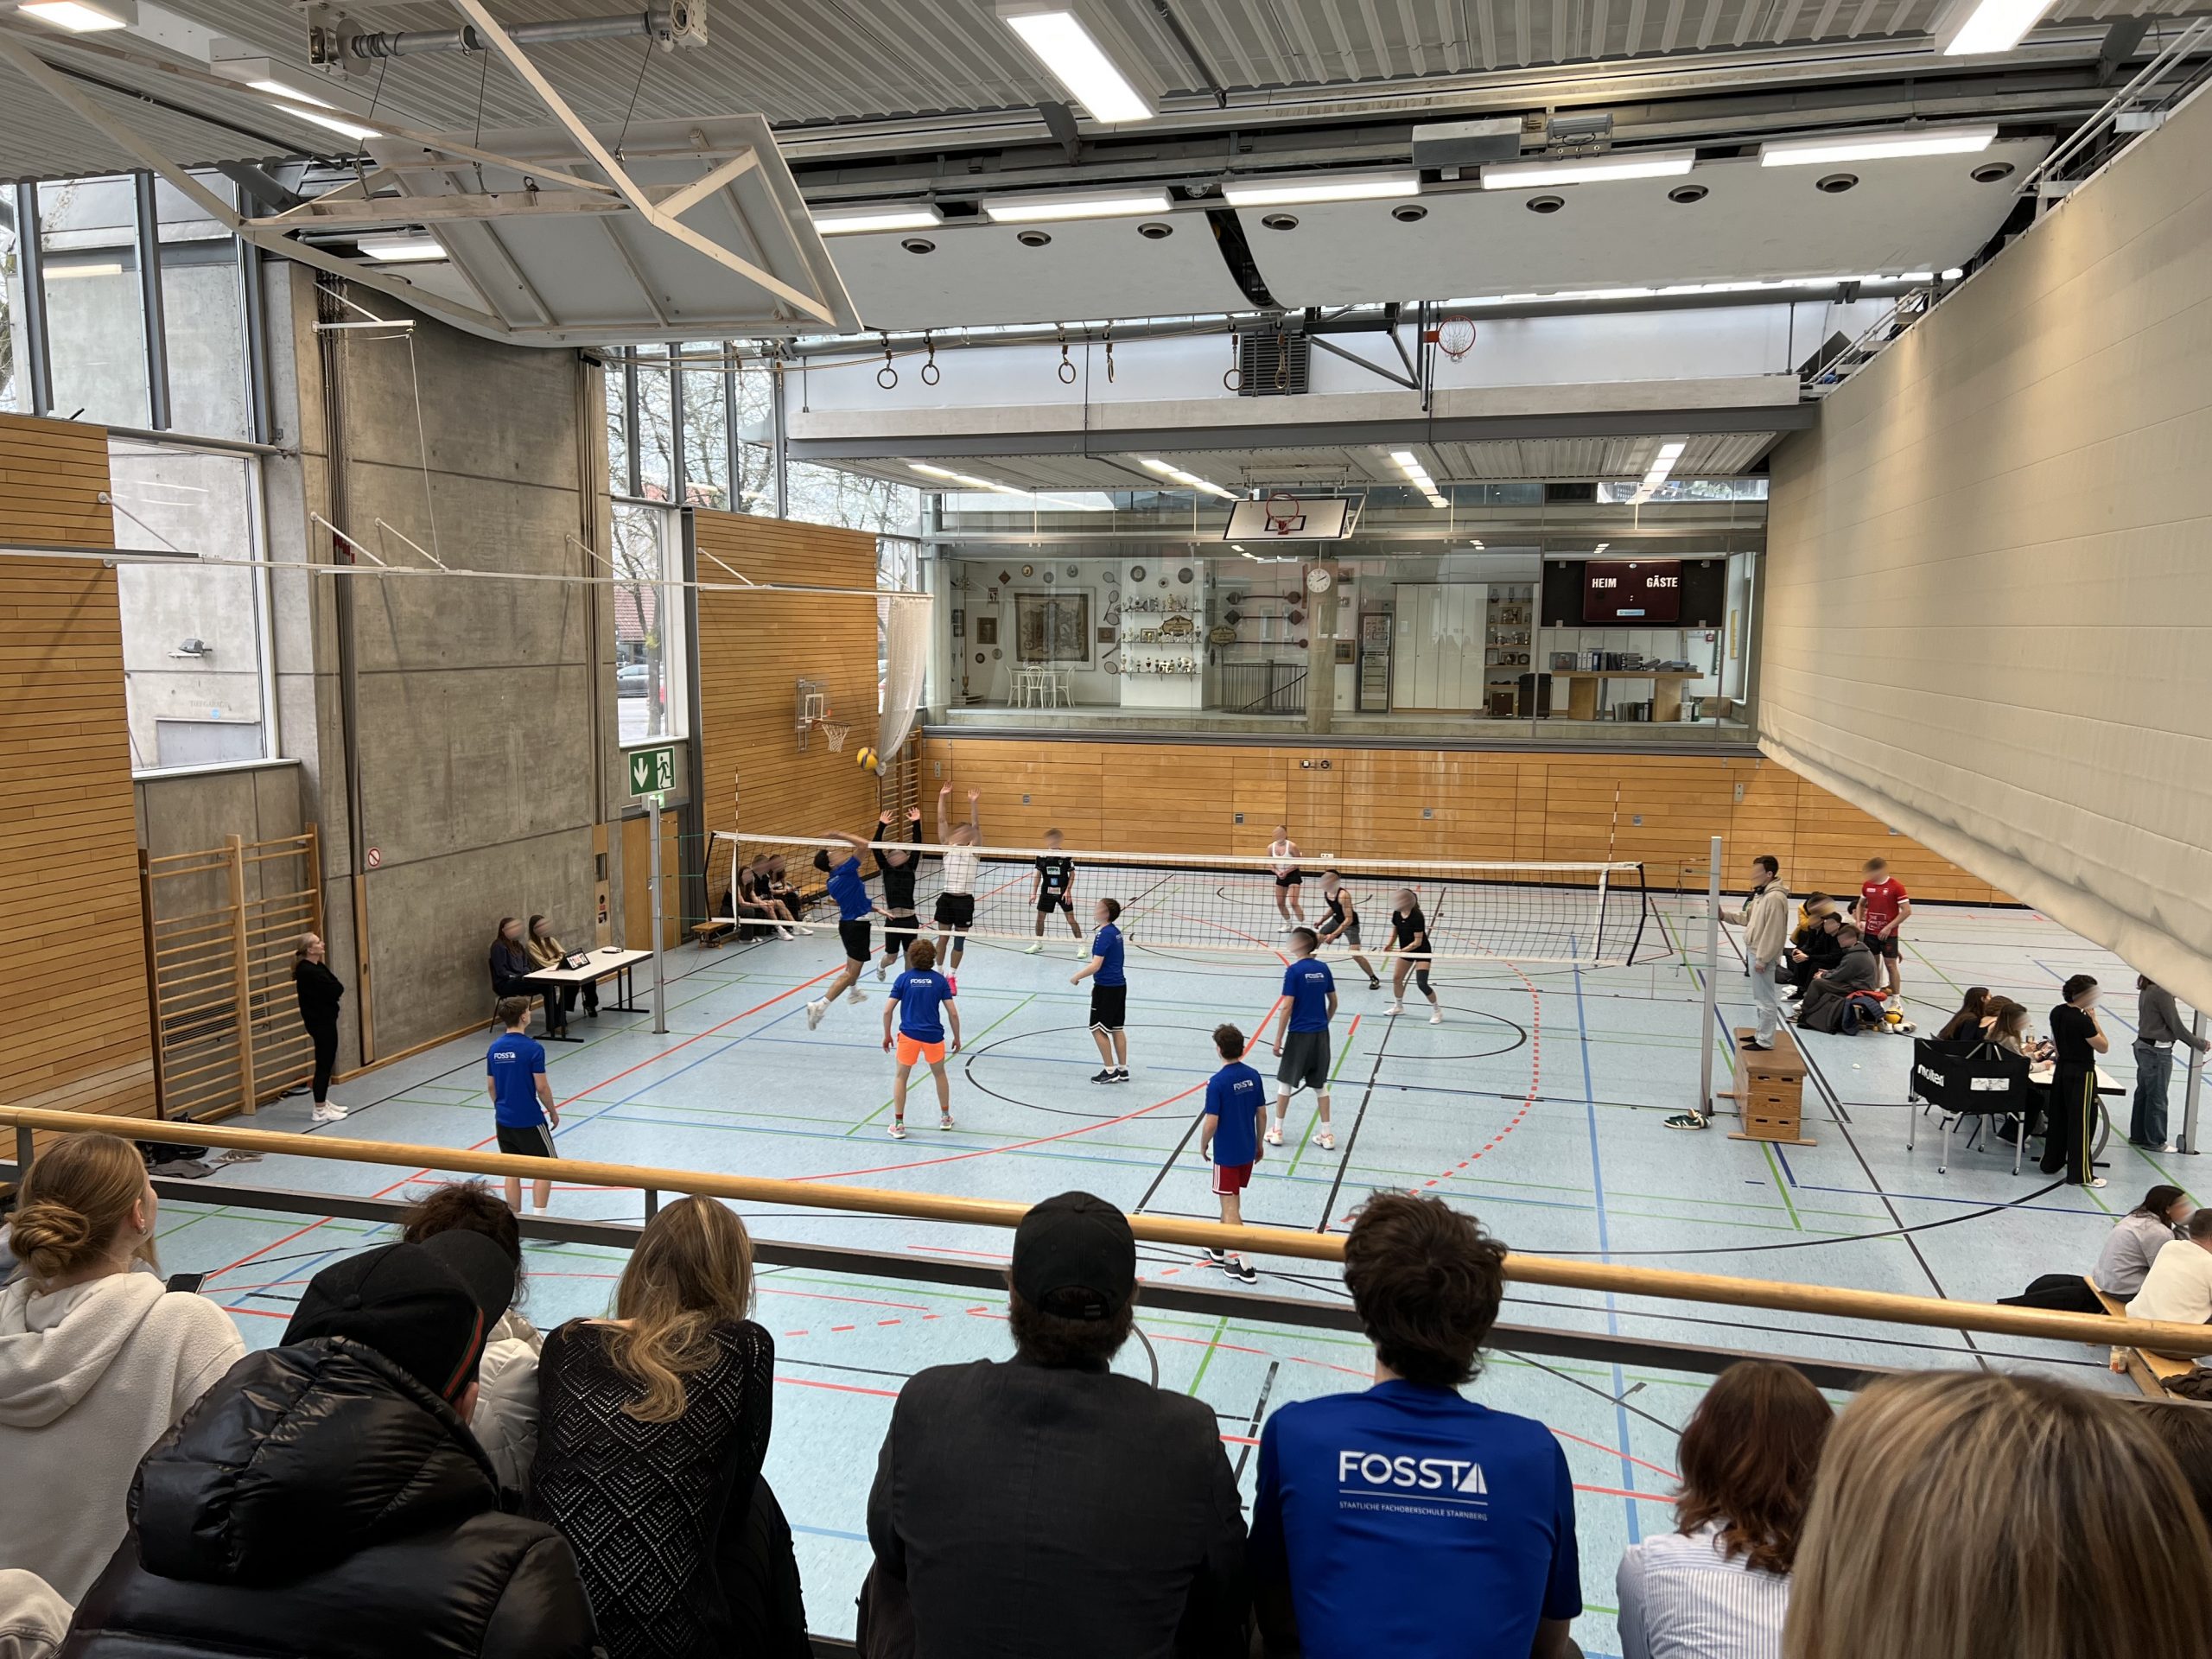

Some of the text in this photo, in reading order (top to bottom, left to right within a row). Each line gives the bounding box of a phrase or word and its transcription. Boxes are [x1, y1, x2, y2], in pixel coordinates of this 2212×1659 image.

[1592, 575, 1679, 588] HEIM GÄSTE
[1917, 1064, 1945, 1087] molten
[1338, 1450, 1489, 1495] FOSSTA
[1339, 1501, 1488, 1522] STAATLICHE FACHOBERSCHULE STARNBERG
